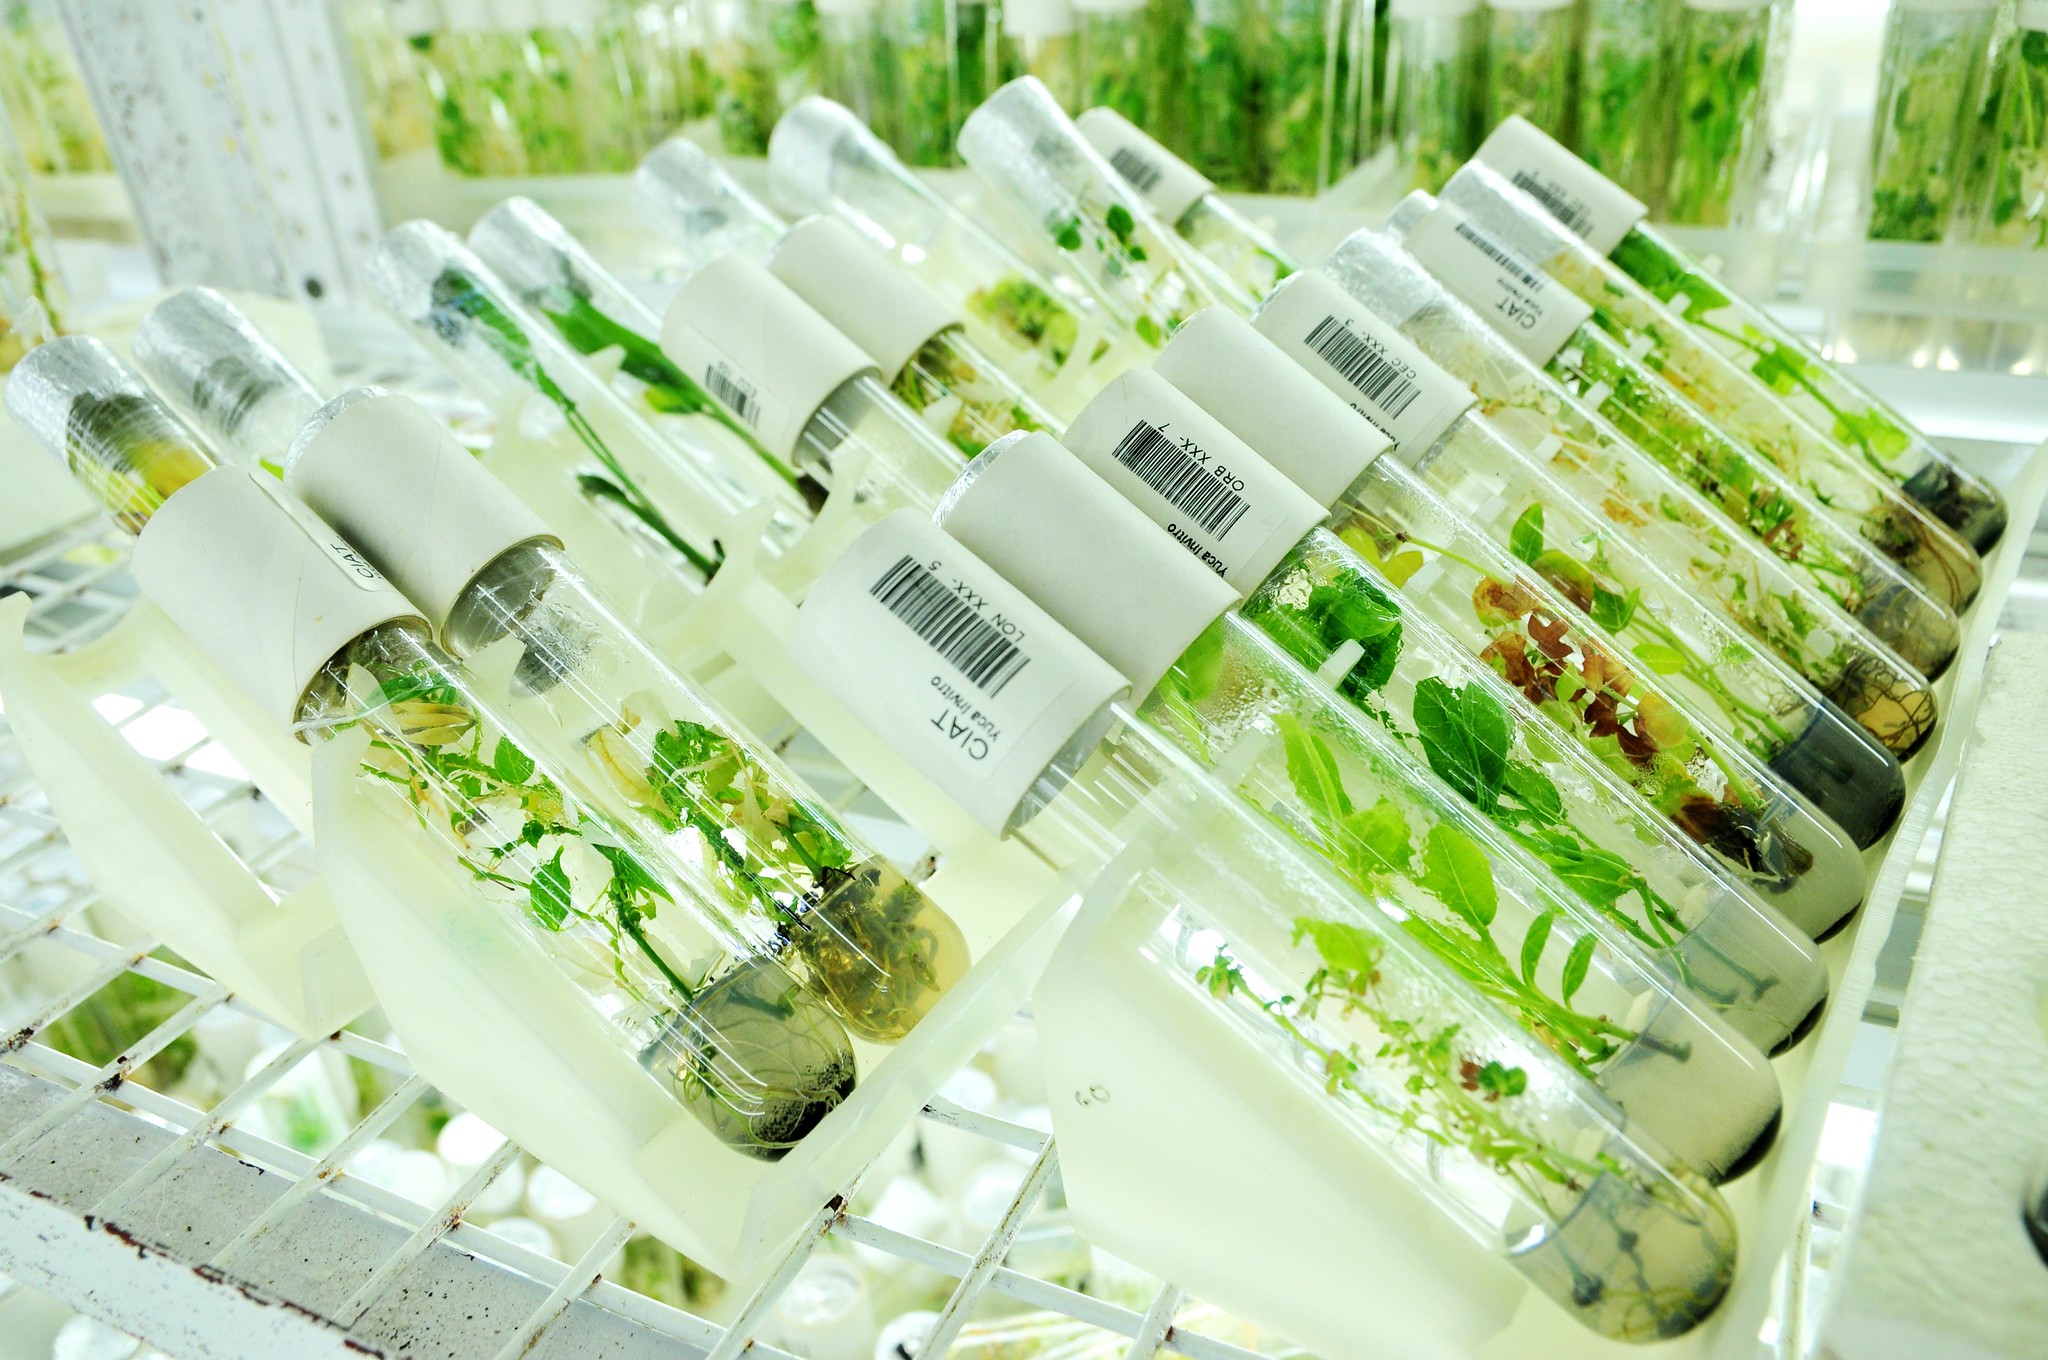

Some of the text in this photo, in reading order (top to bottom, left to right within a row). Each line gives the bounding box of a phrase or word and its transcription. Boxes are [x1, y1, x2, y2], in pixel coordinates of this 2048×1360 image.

[1496, 297, 1535, 328] CIAT
[1391, 358, 1417, 380] CEC
[1158, 423, 1170, 432] 7
[1214, 465, 1245, 492] ORB
[331, 544, 374, 578] CIAT
[929, 560, 941, 571] 5
[1201, 550, 1229, 579] Yuca
[991, 614, 1025, 642] LON
[930, 676, 1002, 742] Yuca Invitro
[930, 709, 988, 761] CIAT
